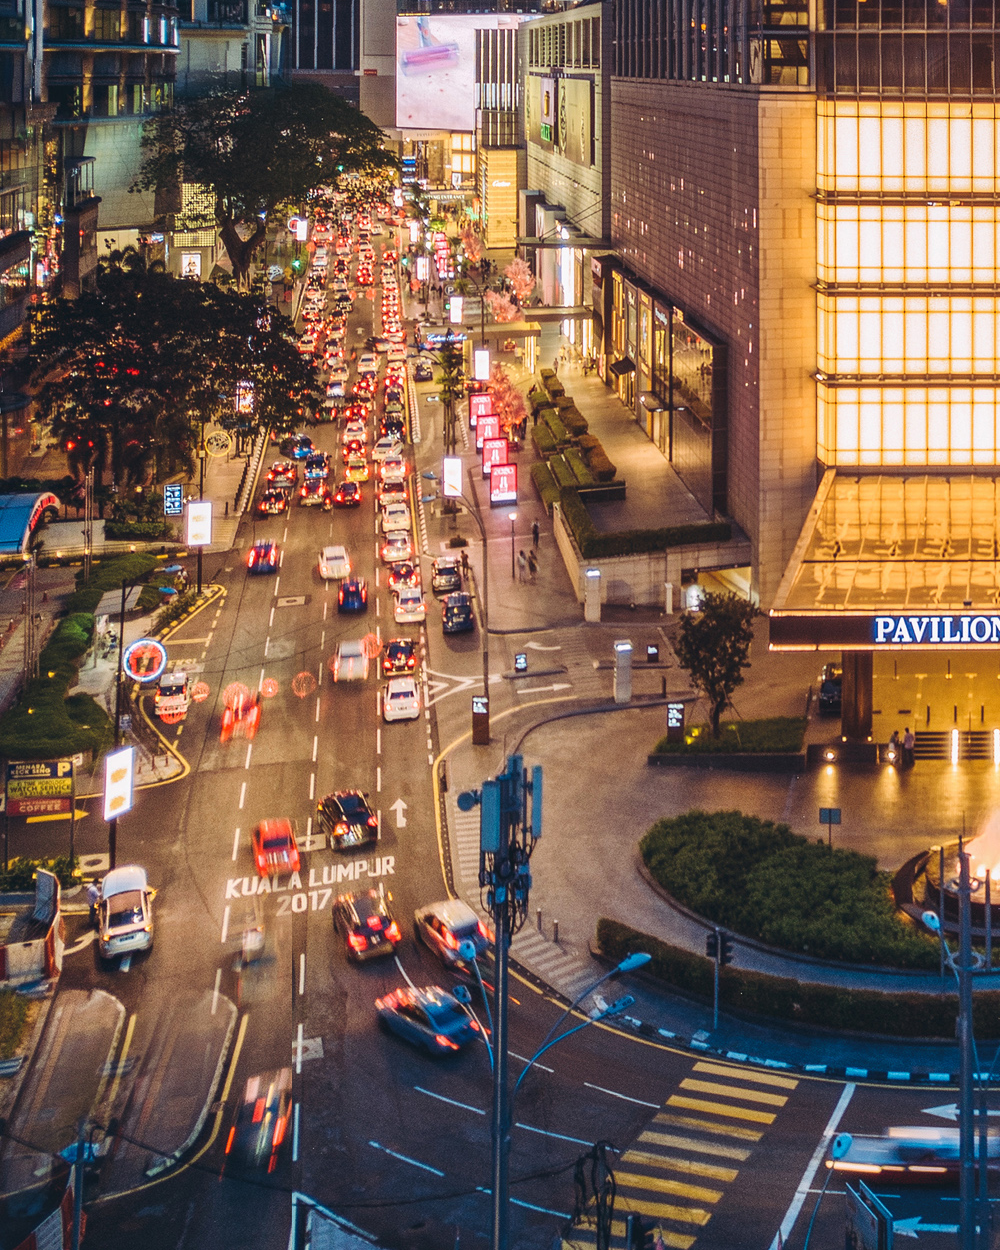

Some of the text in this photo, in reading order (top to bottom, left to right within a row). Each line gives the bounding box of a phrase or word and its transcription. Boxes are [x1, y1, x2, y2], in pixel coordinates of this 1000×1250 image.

[493, 467, 513, 475] 2020
[57, 762, 71, 777] P
[10, 785, 37, 793] WATCH
[19, 804, 61, 813] COFFEE
[225, 855, 395, 899] KUALA LUMPUR
[275, 888, 332, 917] 2017
